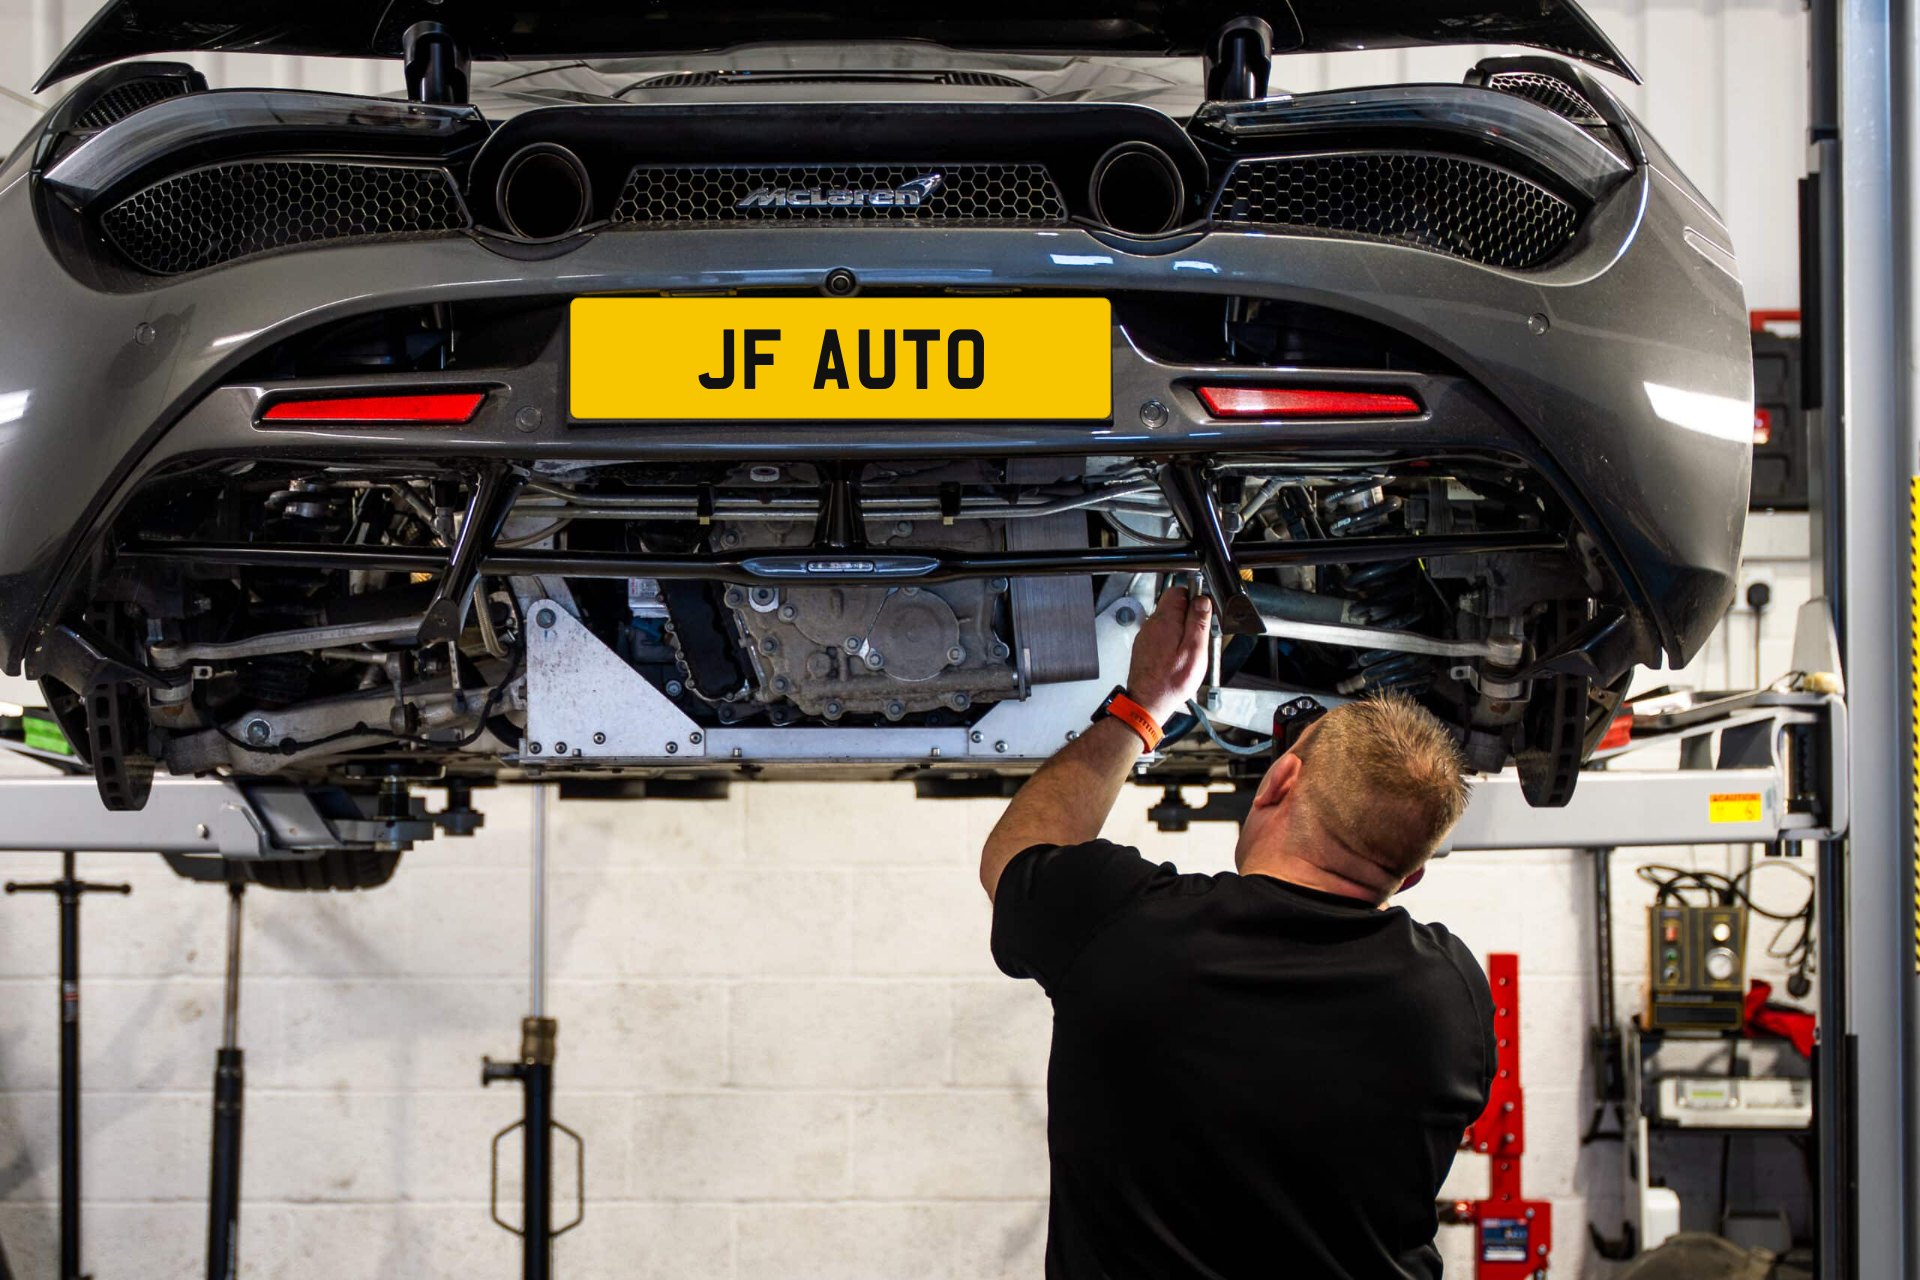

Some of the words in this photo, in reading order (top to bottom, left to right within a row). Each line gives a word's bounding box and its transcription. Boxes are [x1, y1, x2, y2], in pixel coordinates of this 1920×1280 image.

[738, 186, 920, 207] McLaren
[698, 329, 780, 389] JF
[813, 329, 985, 389] AUTO
